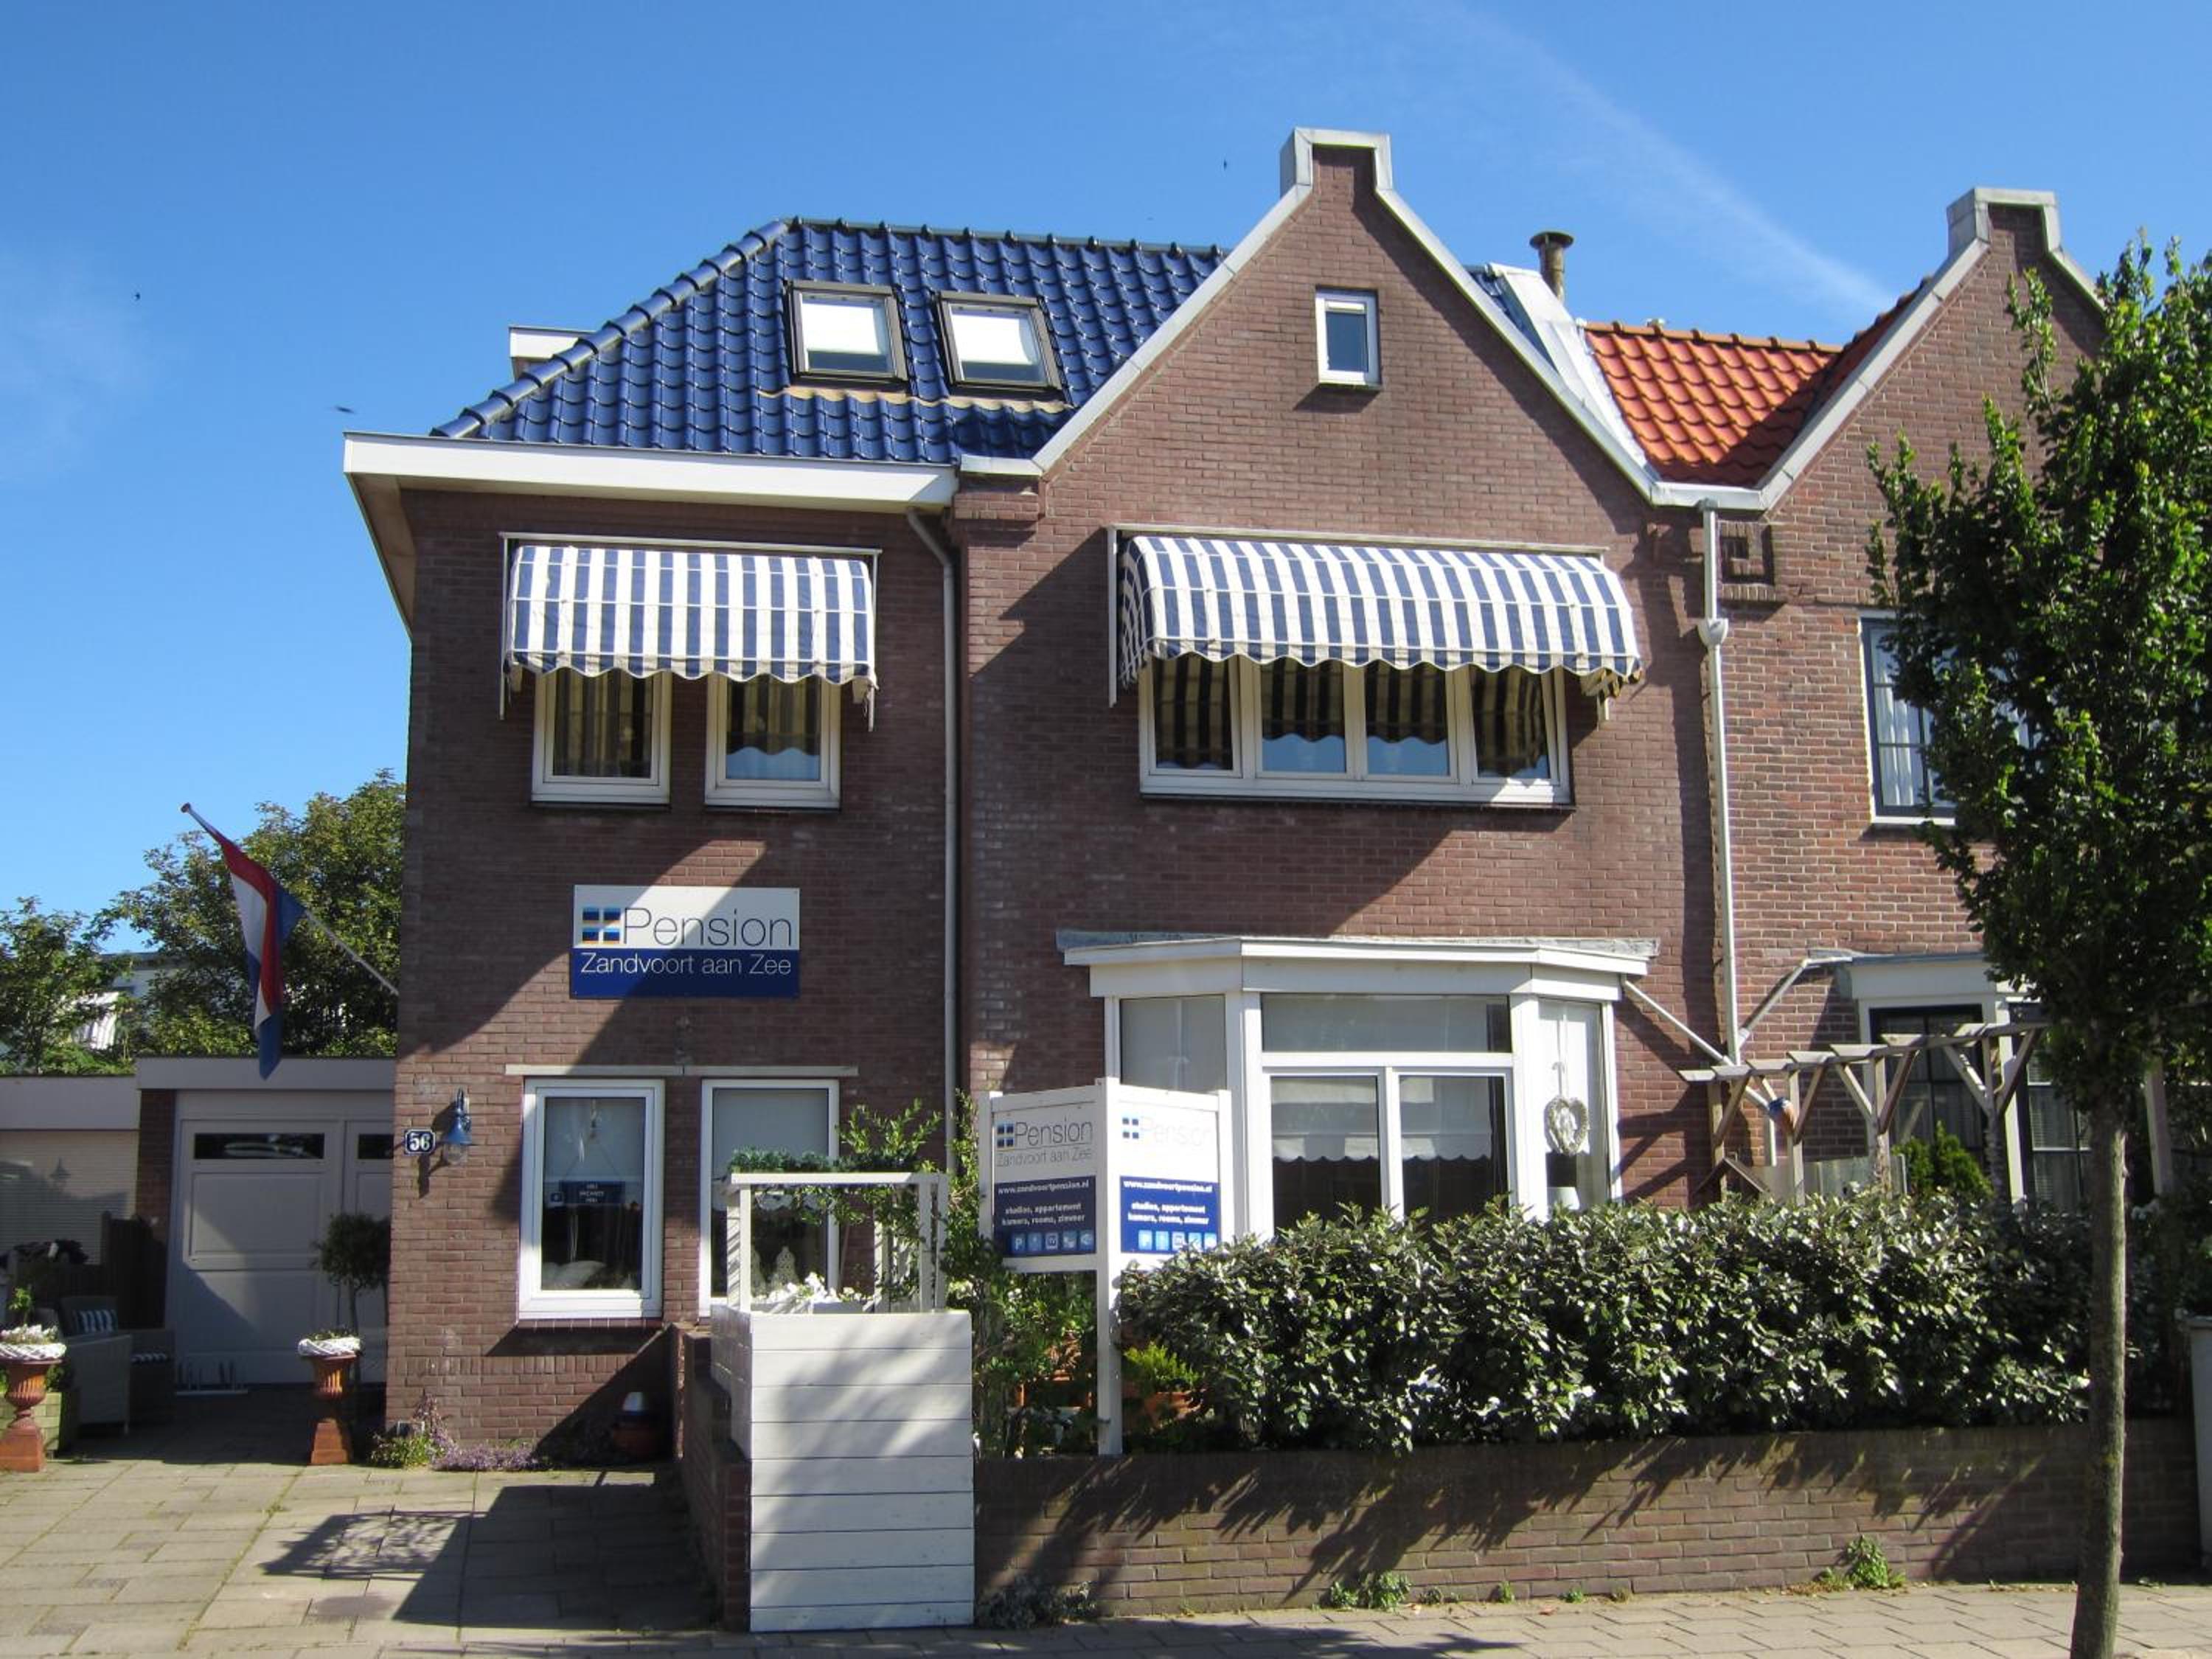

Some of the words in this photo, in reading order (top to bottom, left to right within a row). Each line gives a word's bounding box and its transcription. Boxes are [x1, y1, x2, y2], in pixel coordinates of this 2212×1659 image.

[625, 908, 792, 947] Pension
[581, 953, 693, 974] Zandvoort
[702, 959, 741, 975] aan
[749, 954, 791, 975] Zee
[409, 1133, 431, 1150] 56
[1015, 1116, 1092, 1148] Pension
[1140, 1116, 1212, 1147] Penson
[996, 1150, 1047, 1166] Zandvoort
[1050, 1151, 1070, 1163] aan
[1072, 1147, 1092, 1161] Zee
